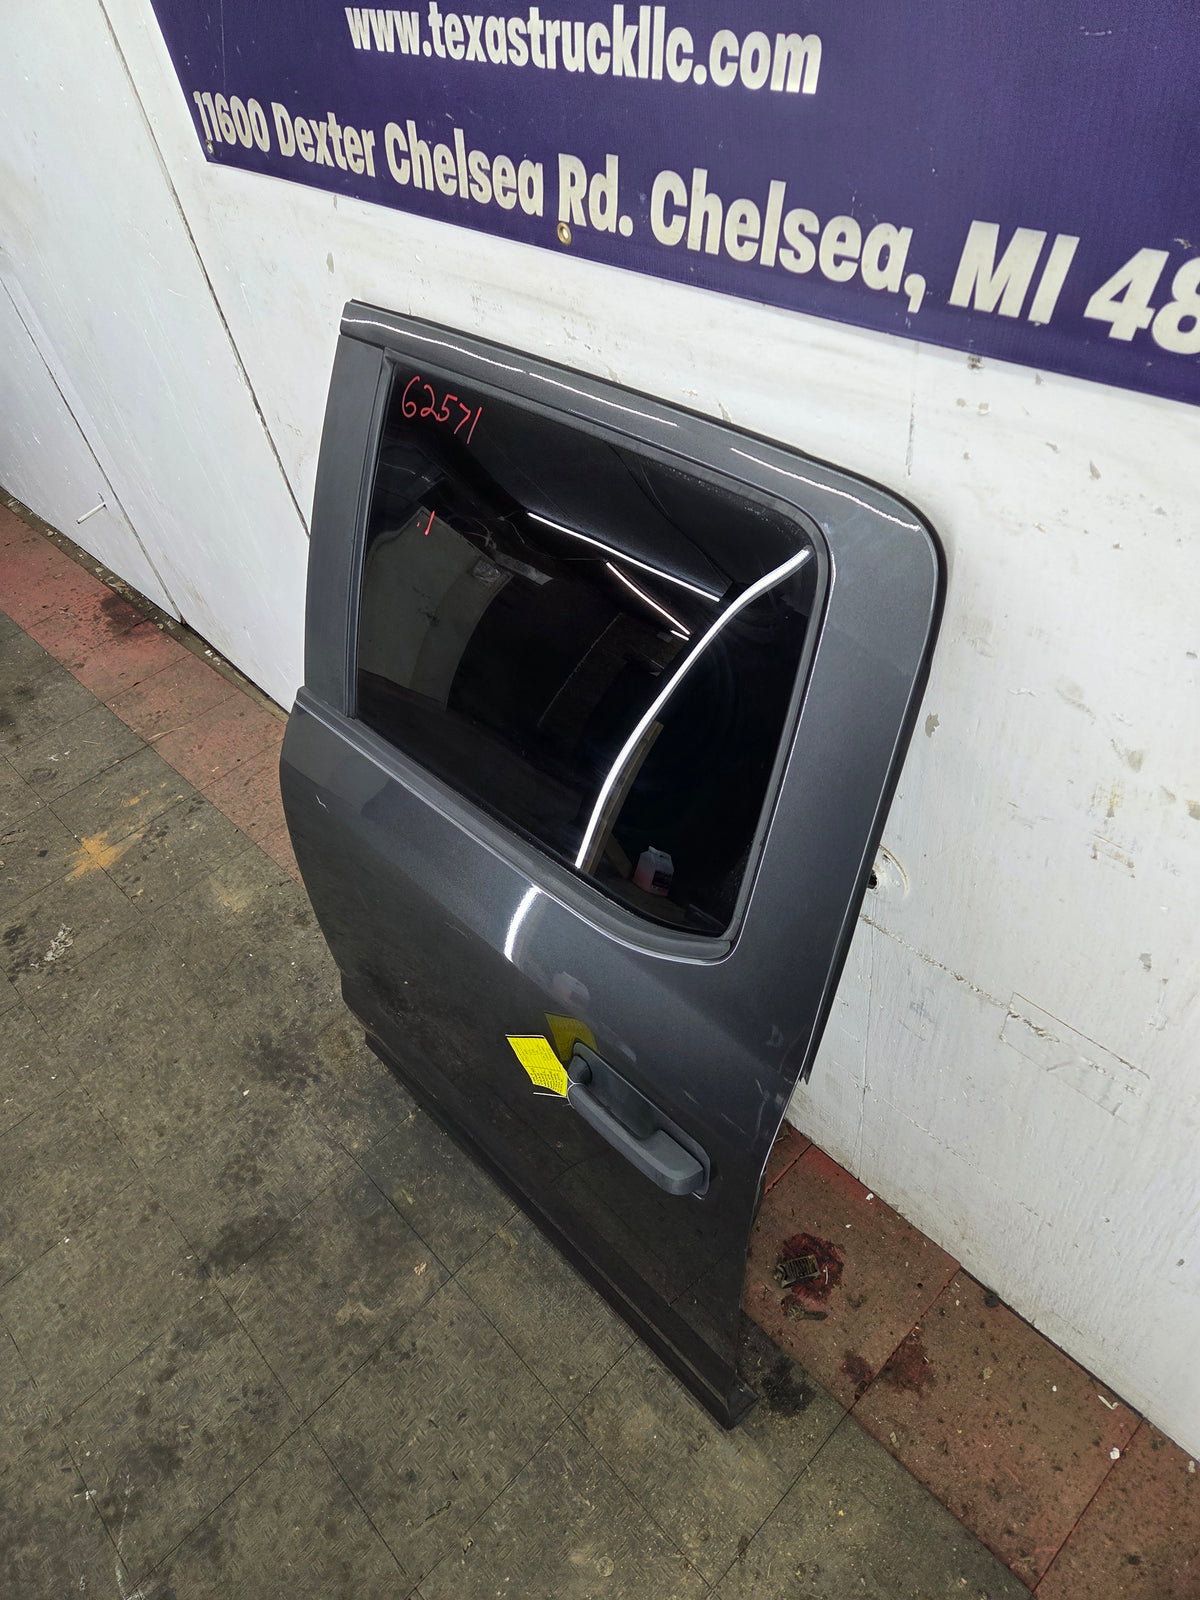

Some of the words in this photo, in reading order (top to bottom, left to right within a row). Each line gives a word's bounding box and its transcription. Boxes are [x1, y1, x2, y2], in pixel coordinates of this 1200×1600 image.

[345, 2, 822, 95] www.texastruckllc.com
[192, 91, 271, 153] 11600
[271, 102, 377, 177] Dexter
[385, 120, 544, 218] Chelsea
[557, 153, 634, 238] Rd.
[650, 168, 927, 314] Chelsea,
[948, 219, 1081, 326] MI
[402, 375, 484, 445] 62571
